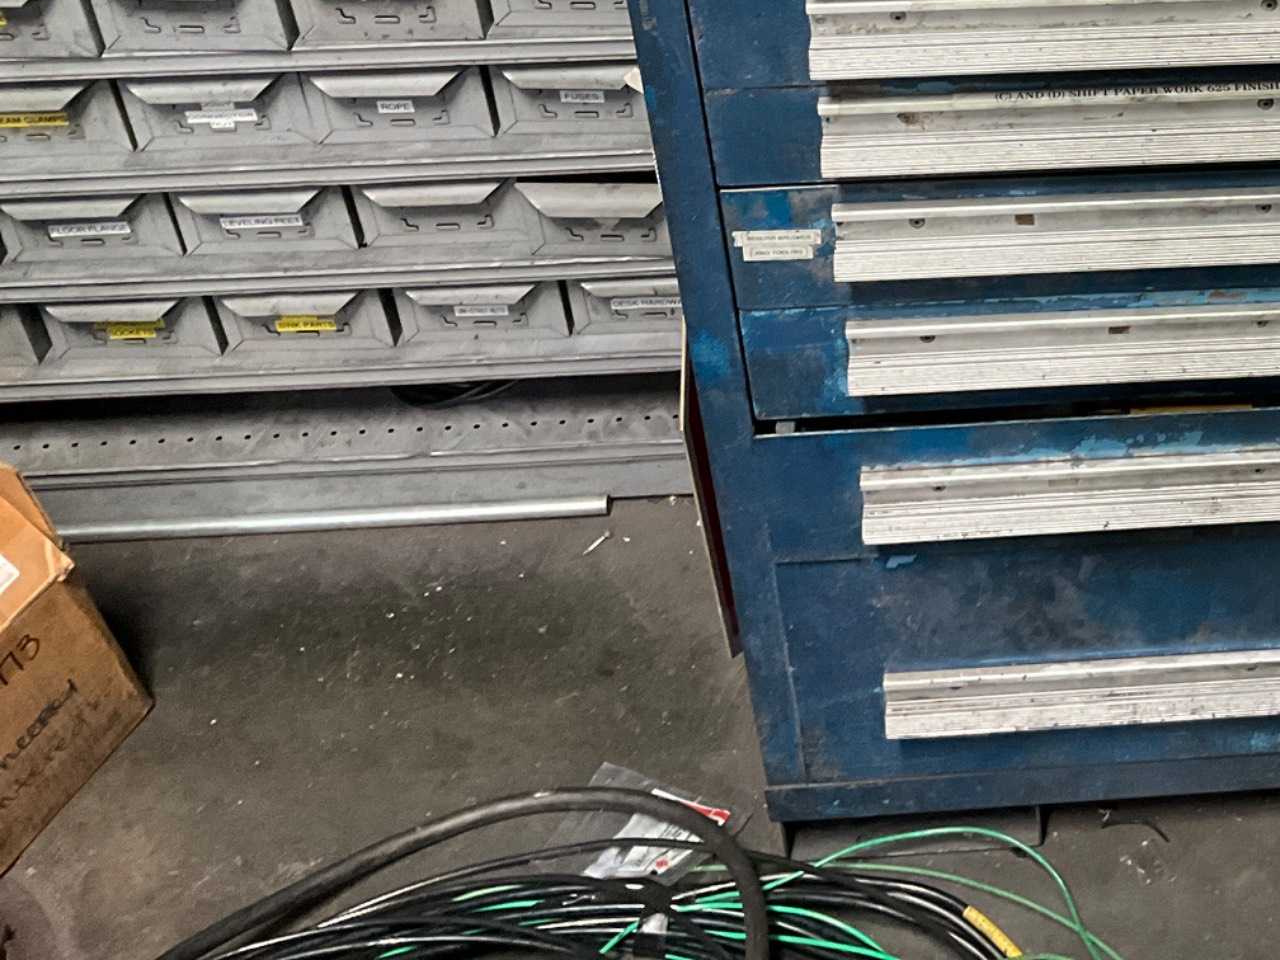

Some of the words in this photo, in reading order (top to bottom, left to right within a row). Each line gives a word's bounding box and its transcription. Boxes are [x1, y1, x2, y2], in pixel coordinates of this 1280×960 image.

[1015, 91, 1045, 100] AND
[1163, 86, 1203, 95] WORK
[381, 101, 410, 111] ROPE
